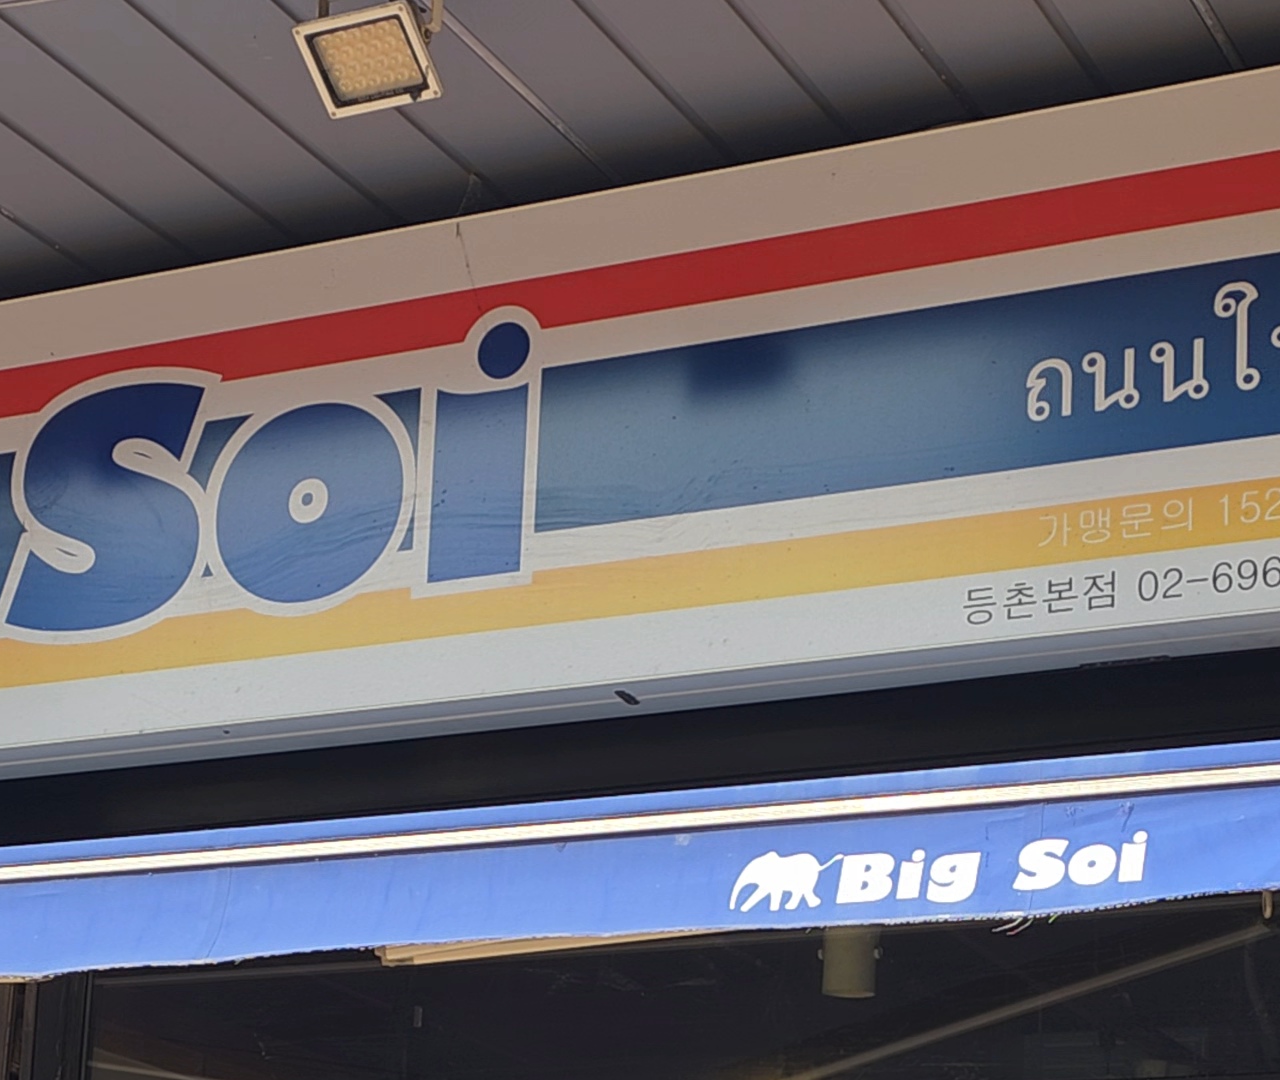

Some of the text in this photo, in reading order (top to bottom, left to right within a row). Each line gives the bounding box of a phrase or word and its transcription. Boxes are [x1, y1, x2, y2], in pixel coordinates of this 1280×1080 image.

[4, 321, 531, 631] Soi
[1037, 497, 1194, 548] 가맹문의
[963, 571, 1117, 625] 등촌본점
[835, 831, 1148, 904] Big Soi
